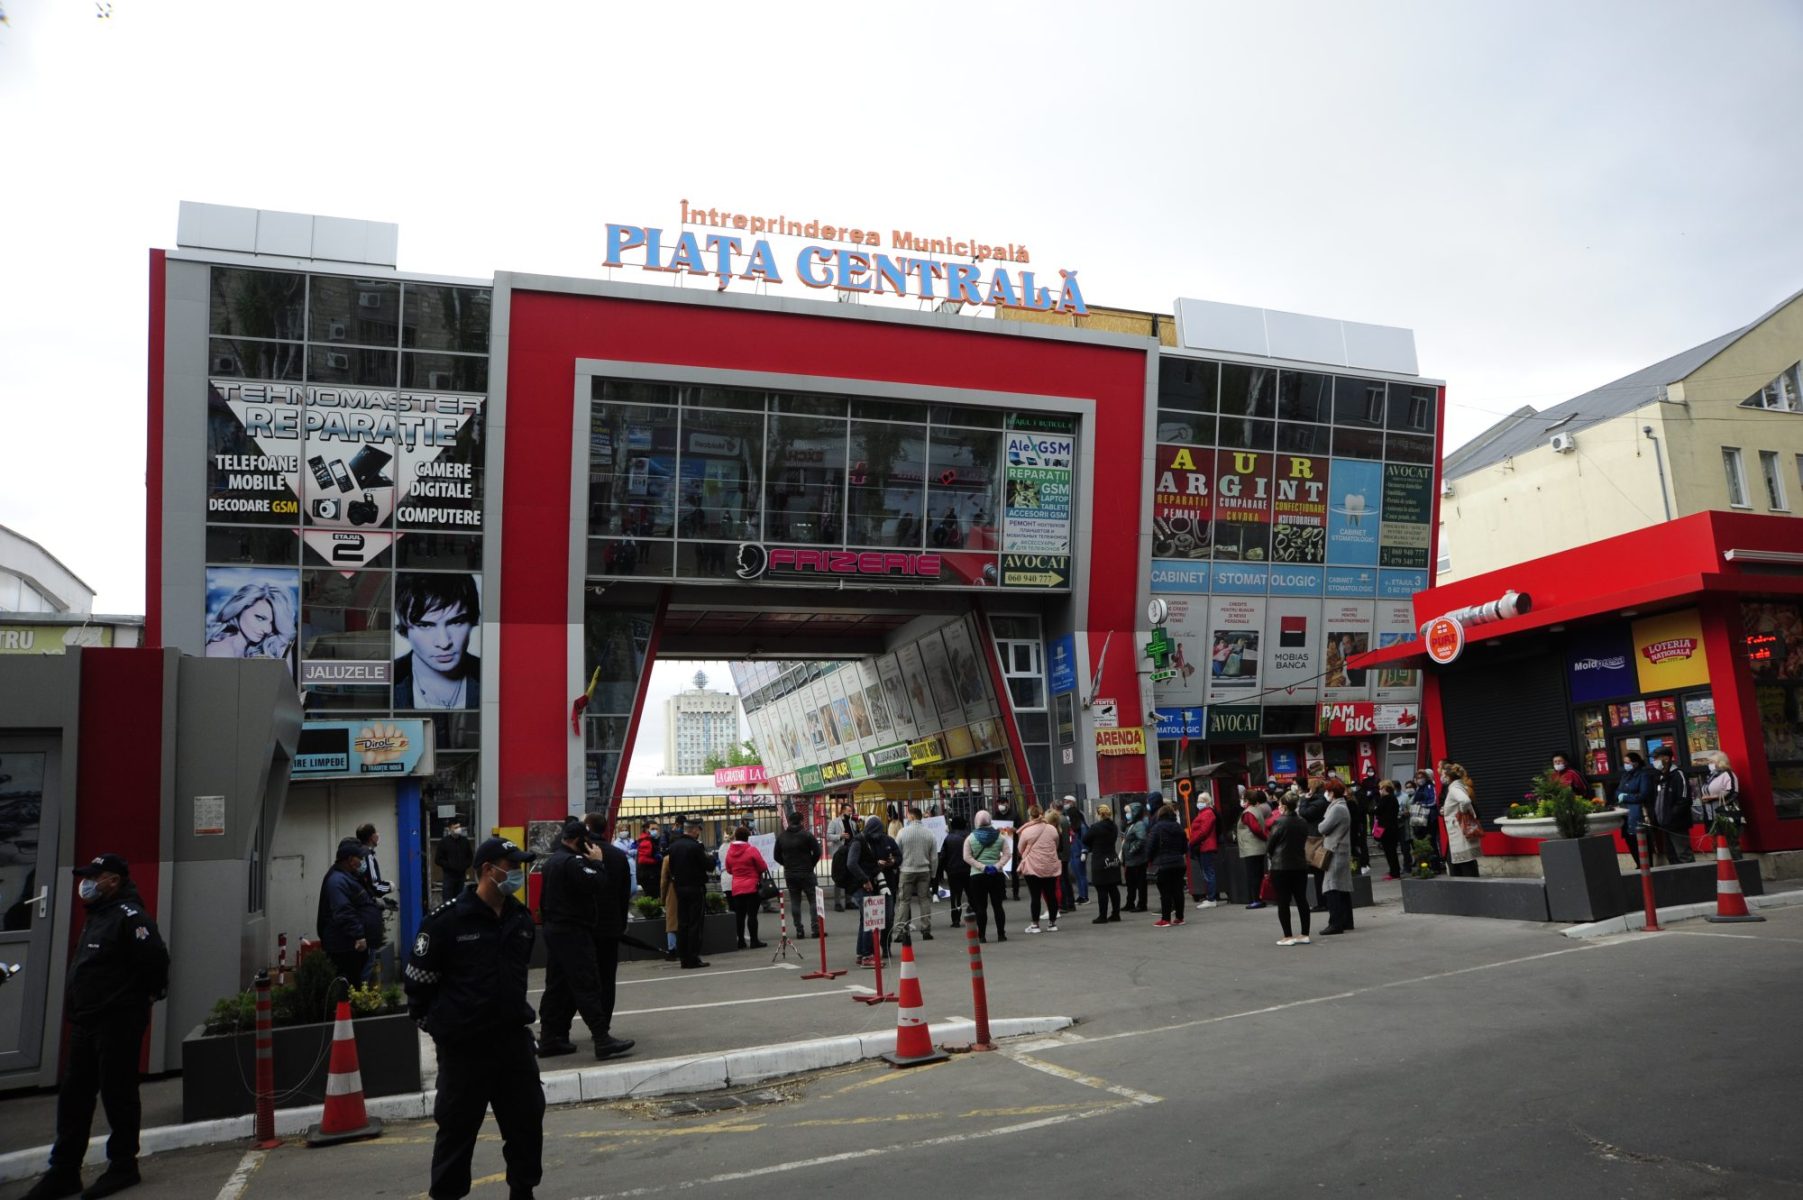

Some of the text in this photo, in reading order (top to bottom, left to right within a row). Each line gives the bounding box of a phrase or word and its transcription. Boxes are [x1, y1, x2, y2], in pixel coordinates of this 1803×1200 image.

[680, 198, 1031, 263] Întreprinderea Municipală
[602, 223, 1091, 317] PIAȚA CENTRALĂ
[215, 382, 485, 415] TEHNOMASTER
[246, 407, 458, 453] REPARAȚIE
[215, 454, 299, 472] TELEFOANE
[415, 461, 472, 479] CAMERE
[1387, 465, 1430, 478] AVOCAT
[228, 473, 286, 491] MOBILE
[410, 480, 473, 499] DIGITALE
[1041, 483, 1069, 495] GSM
[209, 498, 298, 514] DECODARE GSM
[1041, 494, 1069, 503] LAPTOP
[1009, 510, 1049, 518] ACCESORII
[1041, 503, 1069, 511] TABLETE
[397, 506, 481, 525] COMPUTERE
[334, 533, 362, 541] ETAJUL
[1331, 534, 1375, 543] STOMATOLOGIC
[1340, 528, 1367, 536] CABINET
[333, 533, 365, 562] 2
[769, 549, 941, 576] FRIZERIE
[1004, 554, 1067, 569] AVOCAT
[1151, 570, 1205, 584] CABINET
[1415, 576, 1421, 585] 3
[1327, 584, 1373, 592] STOMATOLOGIC
[1648, 639, 1691, 654] LOTERIA
[1275, 653, 1309, 661] MOBIAS
[306, 665, 385, 679] JALUZELE
[1322, 704, 1354, 722] BAM
[1211, 714, 1260, 732] AVOCAT
[1345, 715, 1372, 732] BUC
[1096, 730, 1142, 745] ARENDA
[310, 758, 345, 767] LIMPEDE
